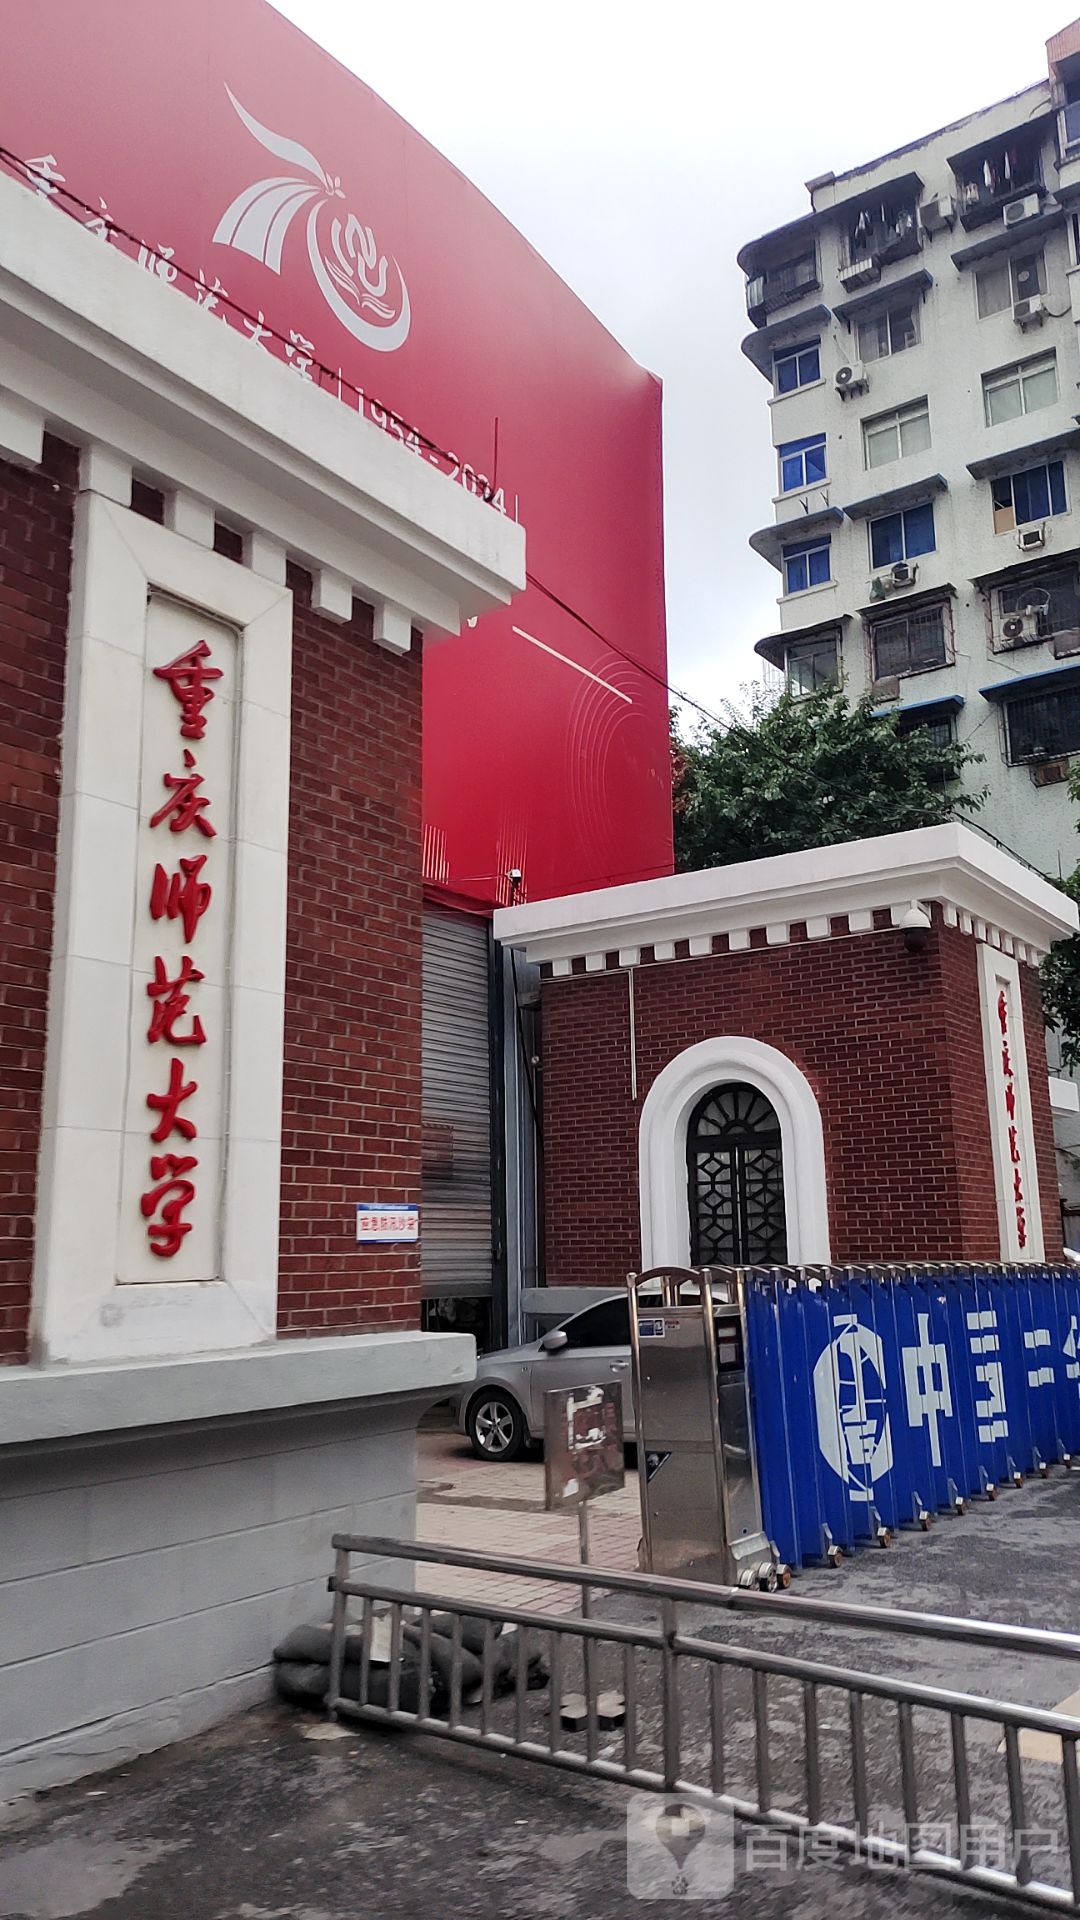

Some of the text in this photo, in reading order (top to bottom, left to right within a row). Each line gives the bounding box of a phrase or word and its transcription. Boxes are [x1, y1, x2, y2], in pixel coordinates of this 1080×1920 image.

[141, 640, 224, 1258] 重庆师范大学
